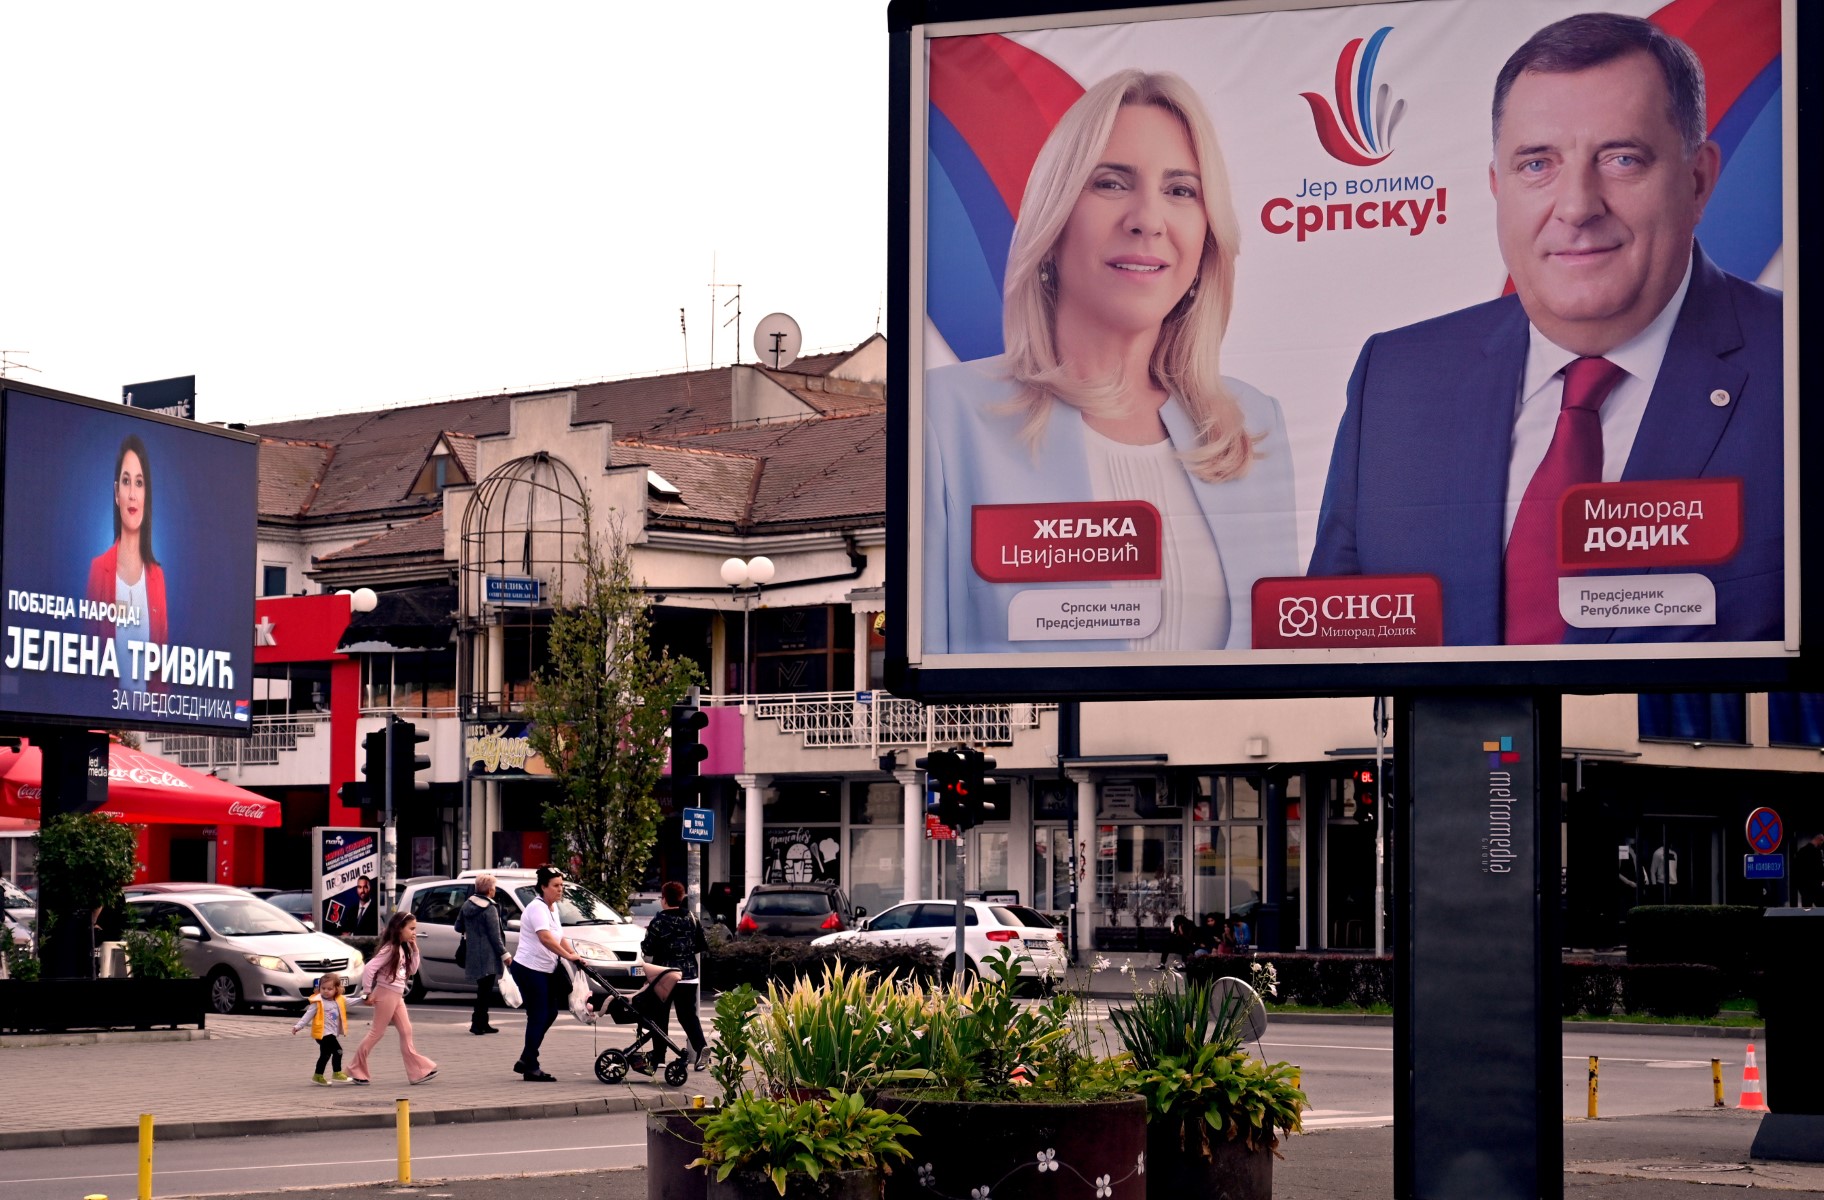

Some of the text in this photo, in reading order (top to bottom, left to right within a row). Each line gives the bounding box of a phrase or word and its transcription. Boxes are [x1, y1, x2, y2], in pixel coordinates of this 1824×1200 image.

[1296, 174, 1434, 200] Јер волимо
[1260, 187, 1447, 242] Српску!
[1584, 498, 1704, 523] Милорад
[1033, 517, 1138, 540] ЖЕЉКА
[1584, 524, 1690, 552] ДОДИК
[1001, 542, 1139, 569] Цвијановић
[1580, 588, 1664, 603] Предсједник
[8, 589, 141, 628] ПОБЈЕДА НАРОДА!
[1061, 602, 1141, 615] Српски члан
[1321, 593, 1416, 624] СНСД
[1580, 602, 1703, 617] Републике Српске
[1036, 616, 1141, 630] Предсједништва
[1321, 625, 1417, 639] Милорад Додик
[5, 626, 234, 690] ЈЕЛЕНА ТРИВИЋ
[112, 689, 232, 721] ЗА ПРЕДСЈЕДНИКА
[88, 756, 99, 767] led
[88, 766, 108, 777] media
[108, 767, 193, 789] a-Cola
[228, 801, 267, 819] Coca-Cola
[1489, 771, 1518, 873] metromedia
[362, 861, 374, 876] СЕ!
[330, 902, 341, 923] 3
